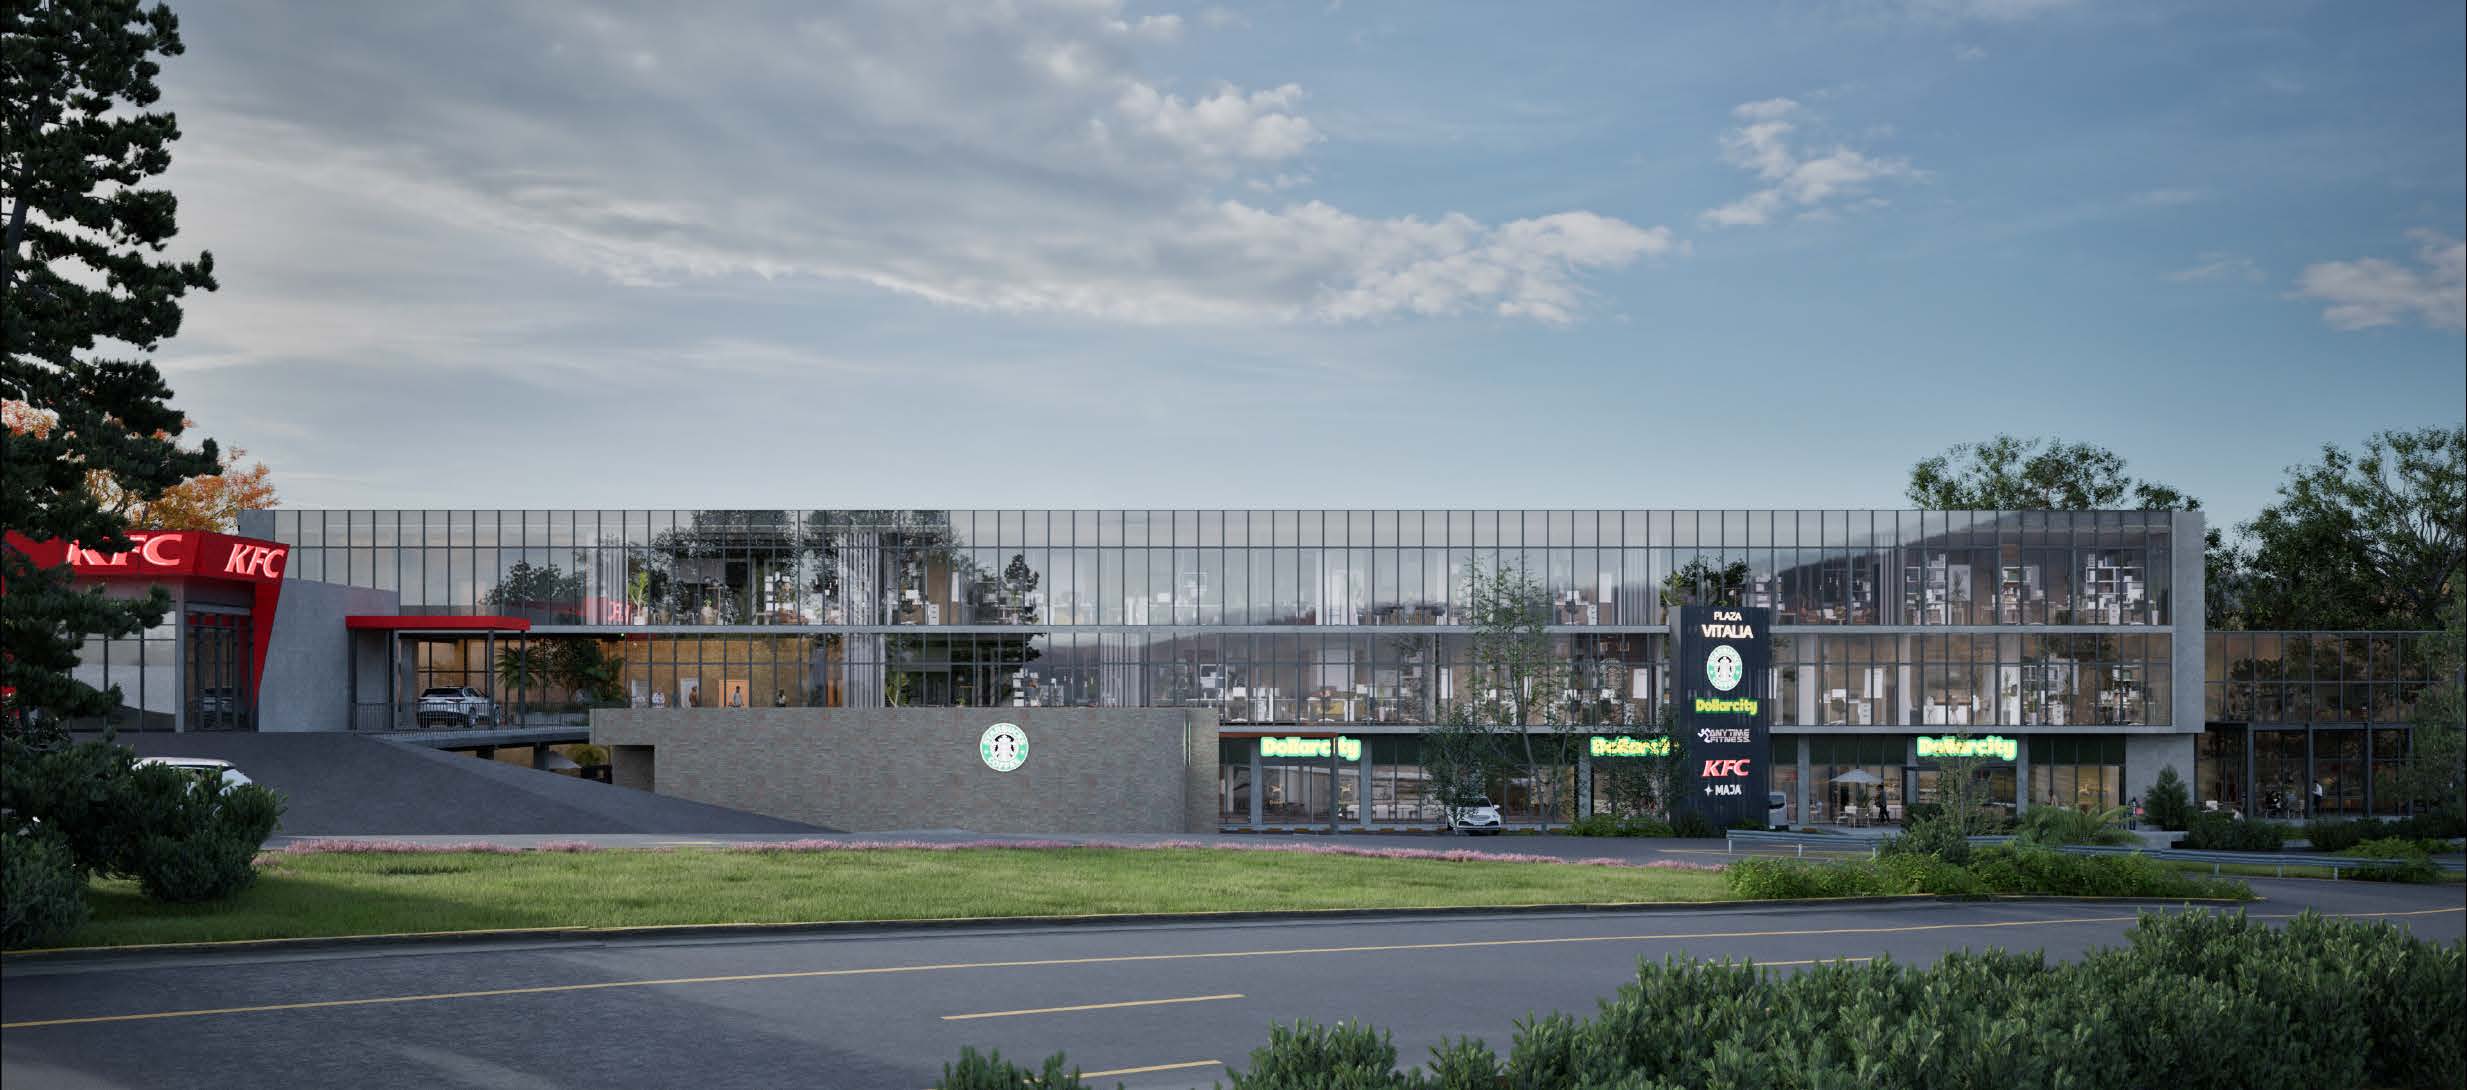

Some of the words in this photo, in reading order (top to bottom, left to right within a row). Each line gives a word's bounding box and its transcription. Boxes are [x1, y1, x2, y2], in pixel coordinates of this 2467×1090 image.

[224, 543, 285, 578] KFC
[1713, 611, 1742, 621] PLAZA
[1701, 624, 1754, 639] VITALIA
[1695, 698, 1758, 716] Dollarcity
[1709, 728, 1750, 737] ANYTIME
[1702, 759, 1751, 777] KFC
[1714, 784, 1742, 796] MAJA
